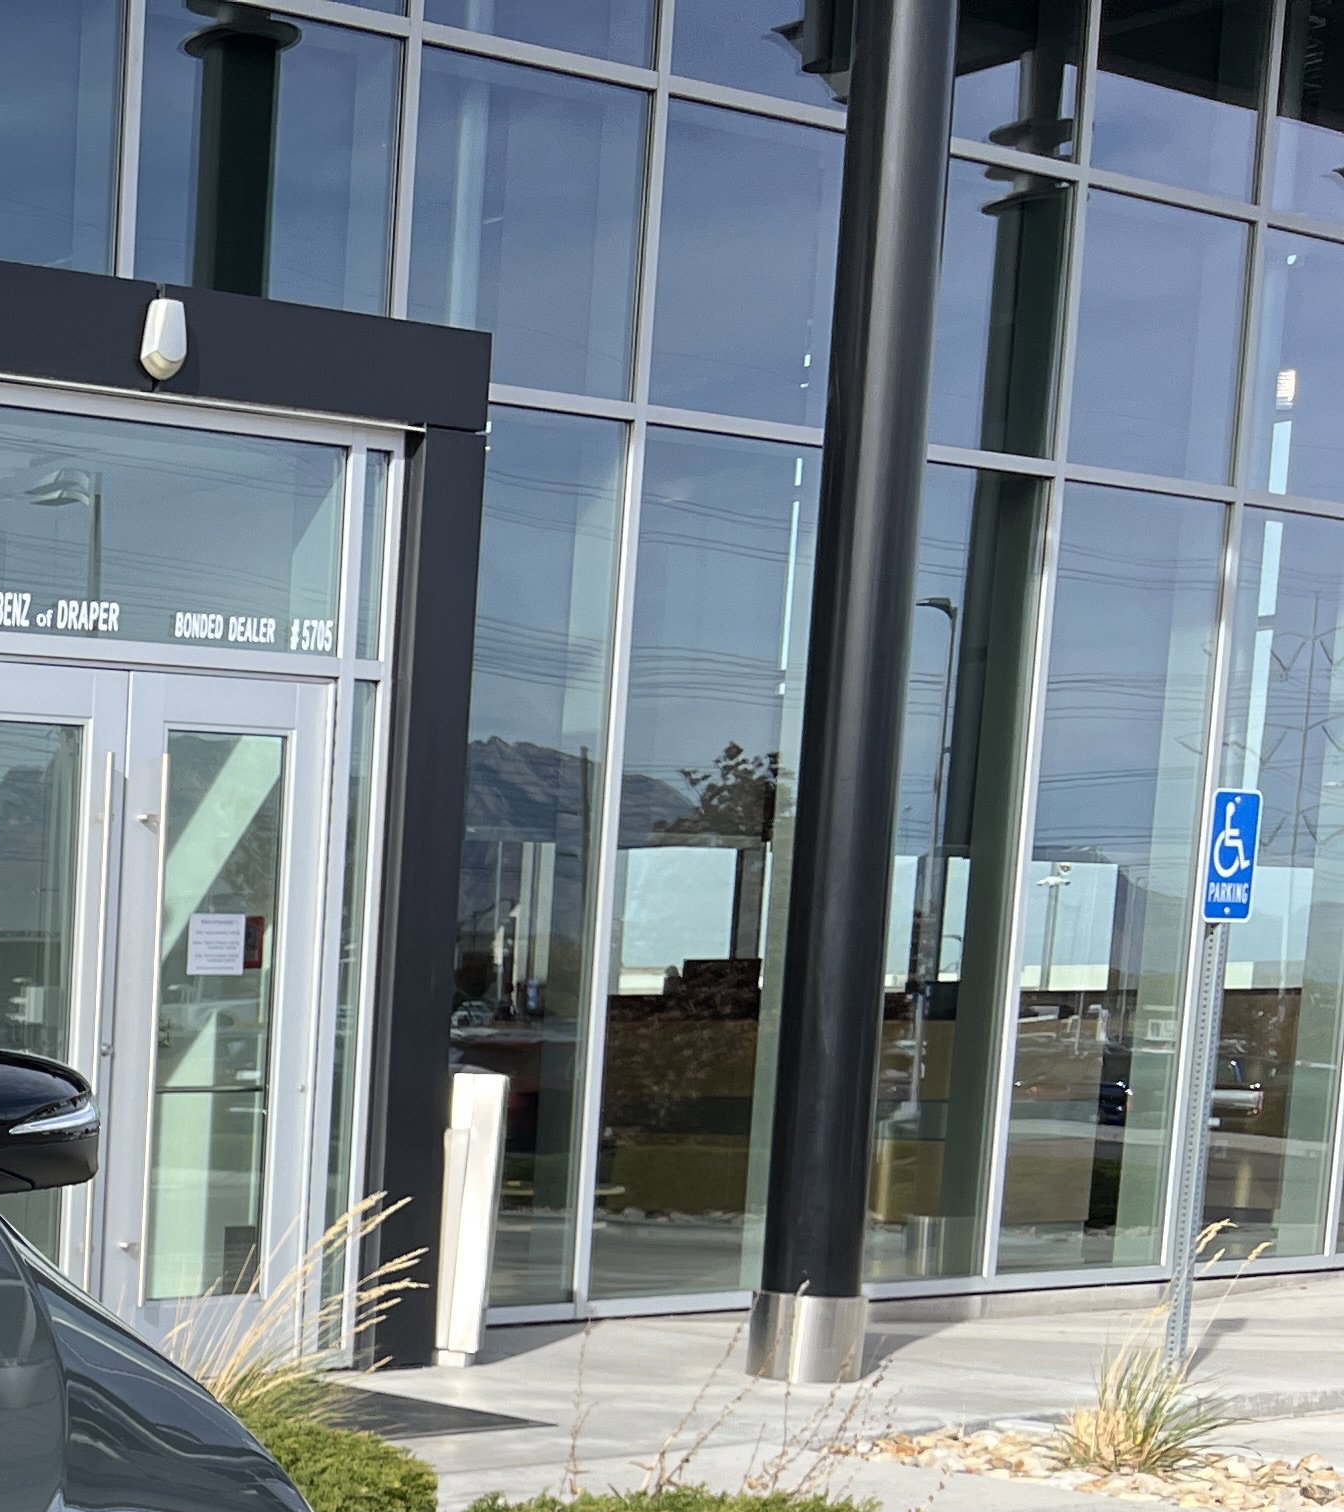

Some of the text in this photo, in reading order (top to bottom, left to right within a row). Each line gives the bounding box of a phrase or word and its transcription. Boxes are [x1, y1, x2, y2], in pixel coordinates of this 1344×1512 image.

[36, 609, 53, 627] of
[57, 600, 120, 631] DRAPER
[174, 612, 224, 640] BONDED
[228, 616, 276, 643] DEALER
[1207, 881, 1249, 904] PARKING
